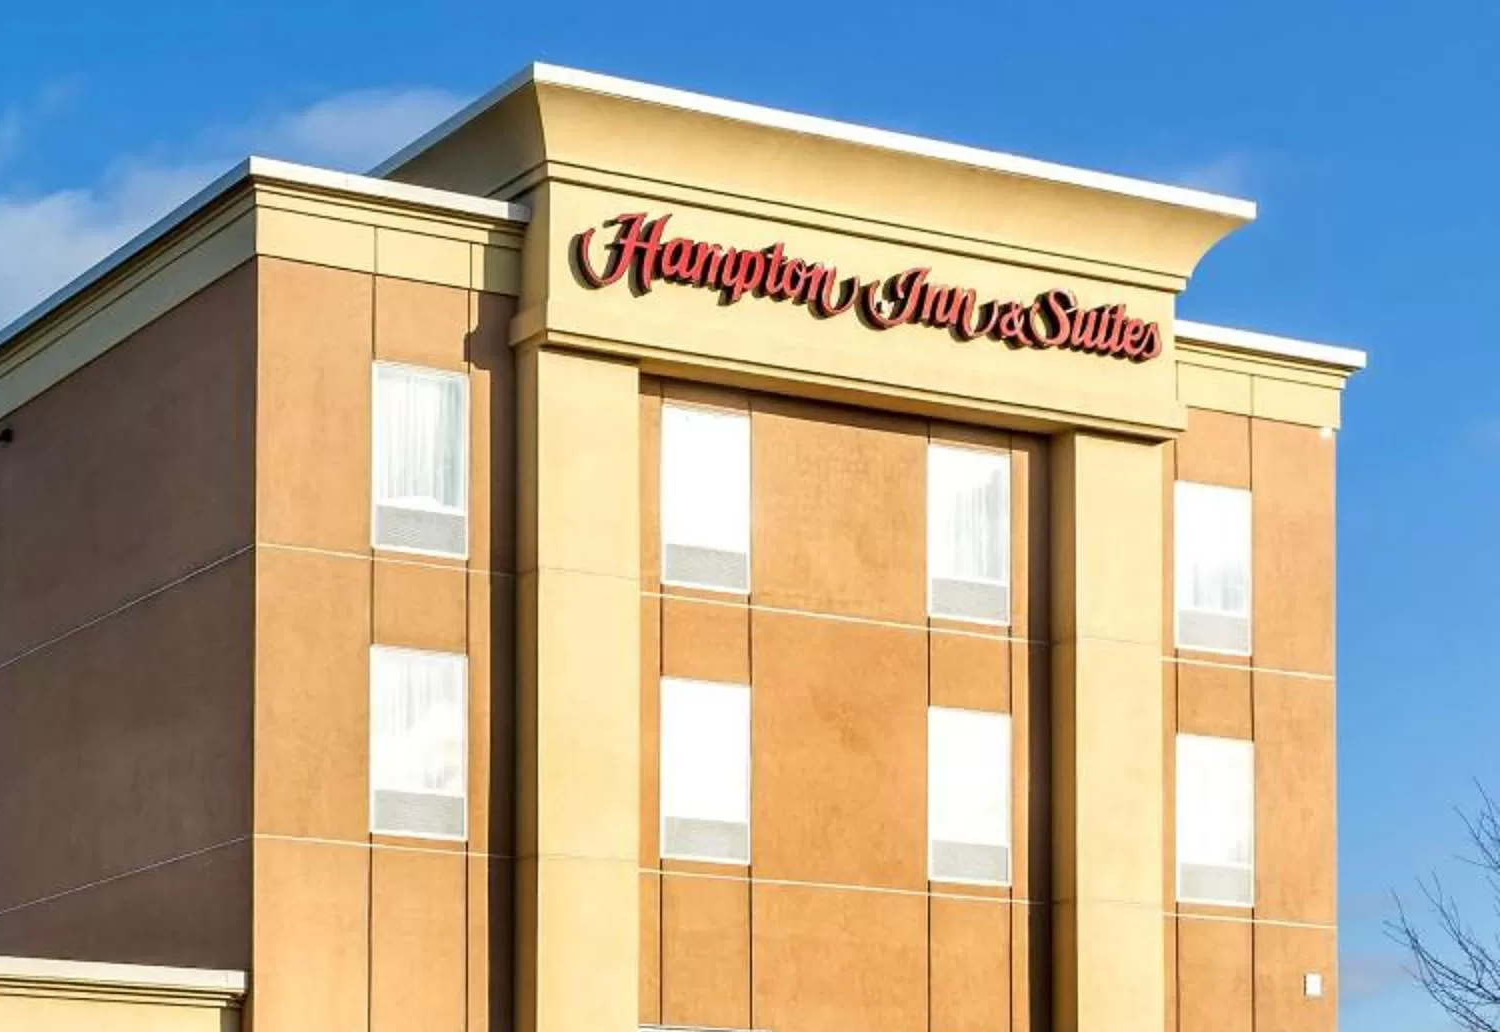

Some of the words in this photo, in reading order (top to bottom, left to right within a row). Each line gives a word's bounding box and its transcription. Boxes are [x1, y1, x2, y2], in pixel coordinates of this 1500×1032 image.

[570, 212, 860, 318] Hampton
[862, 266, 999, 338] Inn
[999, 301, 1032, 348] &
[1029, 287, 1163, 361] Suites
